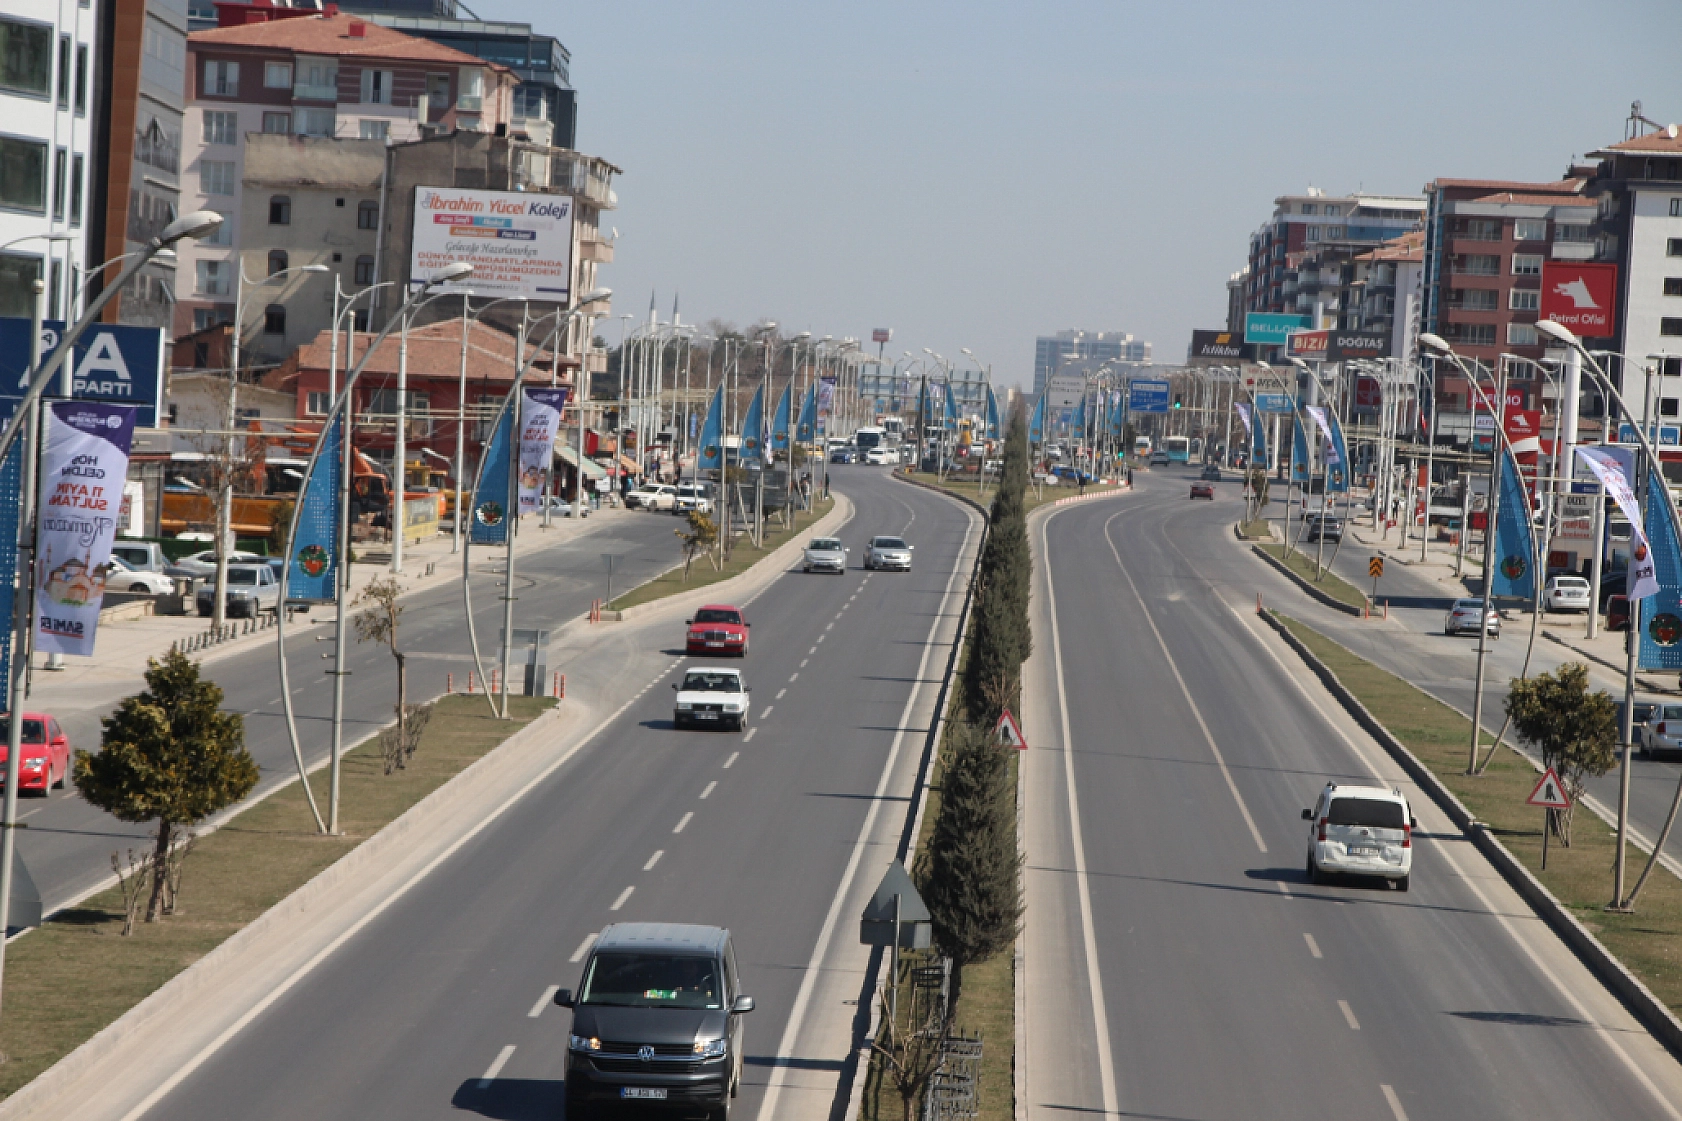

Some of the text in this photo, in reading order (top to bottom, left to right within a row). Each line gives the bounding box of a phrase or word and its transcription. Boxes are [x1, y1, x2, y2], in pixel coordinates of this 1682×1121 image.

[429, 192, 484, 212] İbrahim
[490, 198, 526, 215] Yücel
[528, 201, 570, 219] Koleji
[417, 251, 563, 268] DÜNYA STANDARTLARINDA
[1549, 313, 1606, 325] Petrol Ofisi
[75, 332, 132, 379] A
